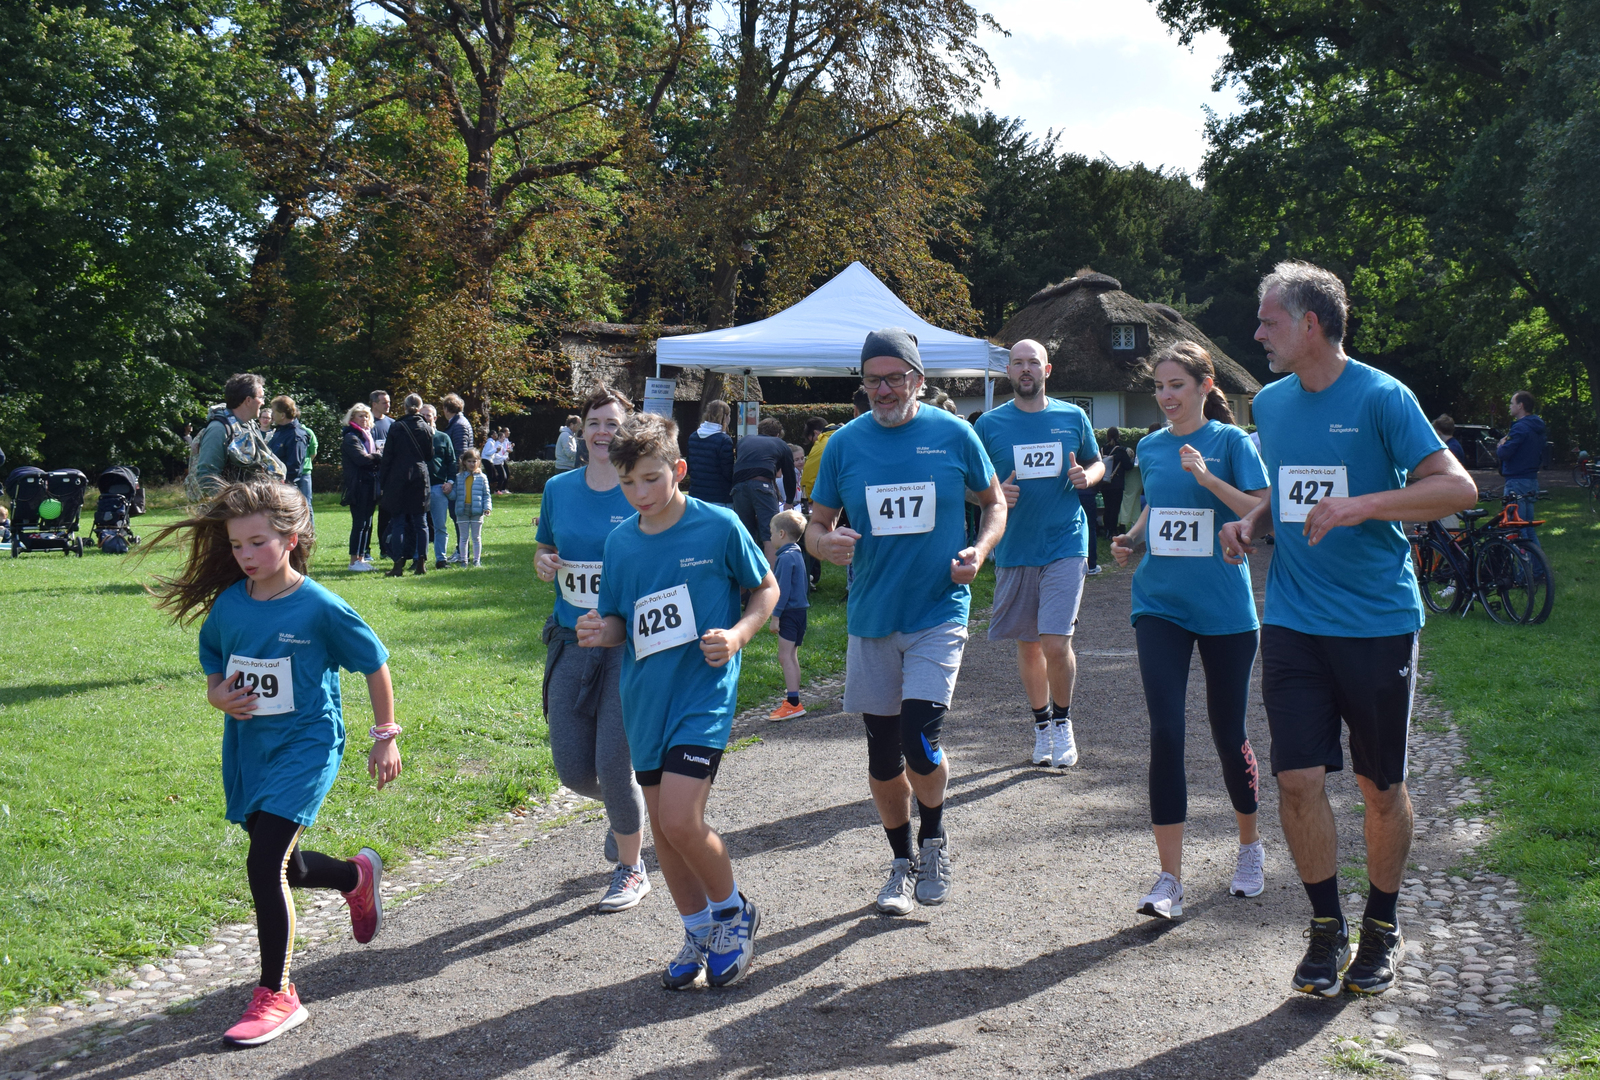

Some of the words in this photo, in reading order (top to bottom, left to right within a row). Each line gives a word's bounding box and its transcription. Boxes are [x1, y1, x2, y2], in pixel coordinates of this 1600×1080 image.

[1023, 451, 1055, 468] 422
[876, 484, 926, 493] Jenisch-Park-Lauf
[1289, 480, 1334, 505] 427
[879, 495, 924, 519] 417
[1159, 520, 1199, 542] 421
[565, 572, 602, 595] 416
[638, 603, 682, 638] 428
[232, 657, 280, 668] Jenisch-Park-Lauf
[234, 671, 279, 699] 429
